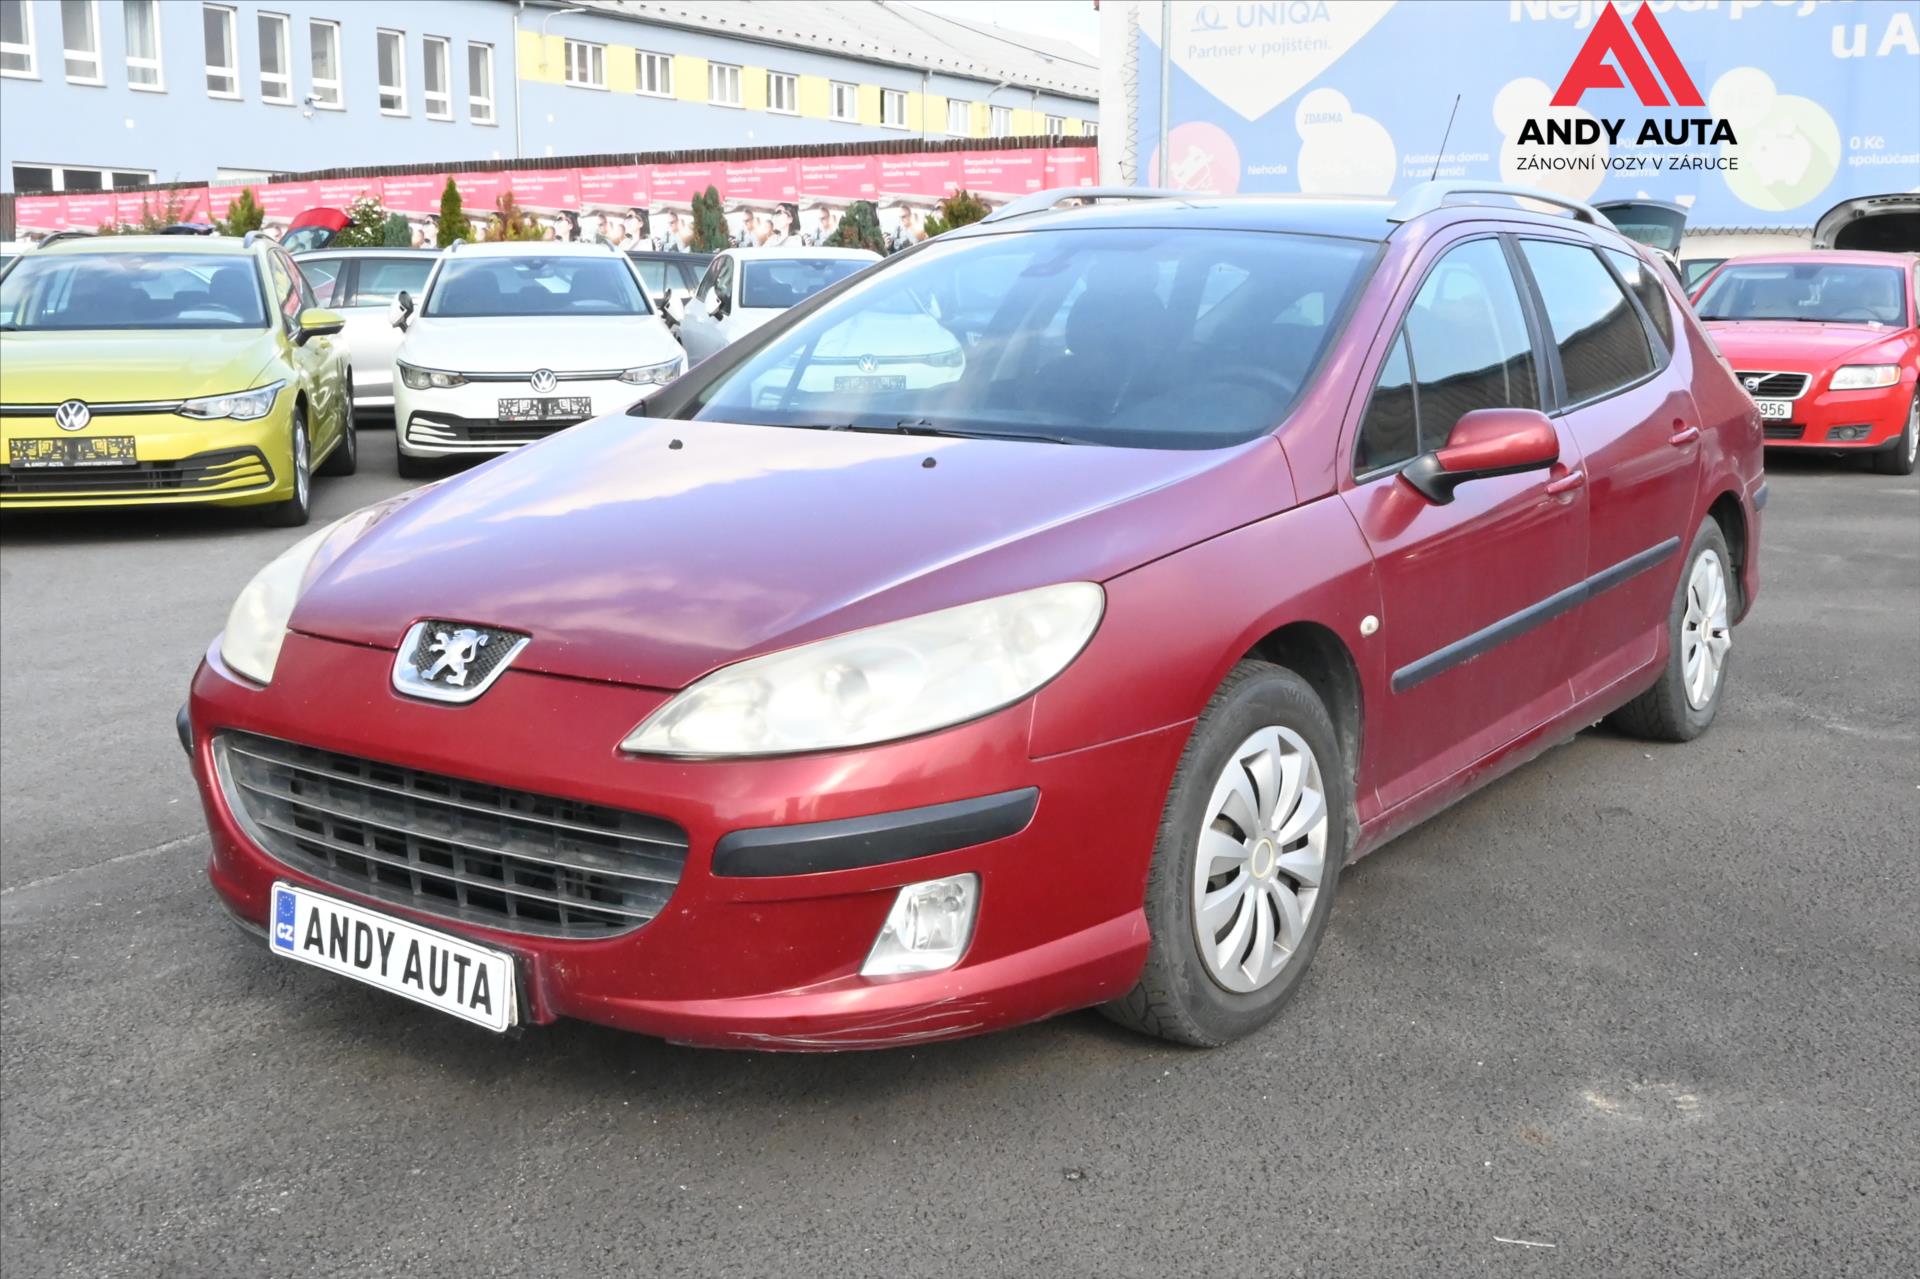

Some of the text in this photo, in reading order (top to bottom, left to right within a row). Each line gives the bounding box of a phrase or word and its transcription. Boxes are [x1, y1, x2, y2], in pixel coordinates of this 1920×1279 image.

[1236, 1, 1331, 28] UNIQA
[1188, 44, 1243, 60] Partner
[1832, 24, 1867, 58] u
[1756, 403, 1785, 416] 956
[277, 922, 294, 942] CZ
[303, 906, 492, 1016] ANDY AUTA
